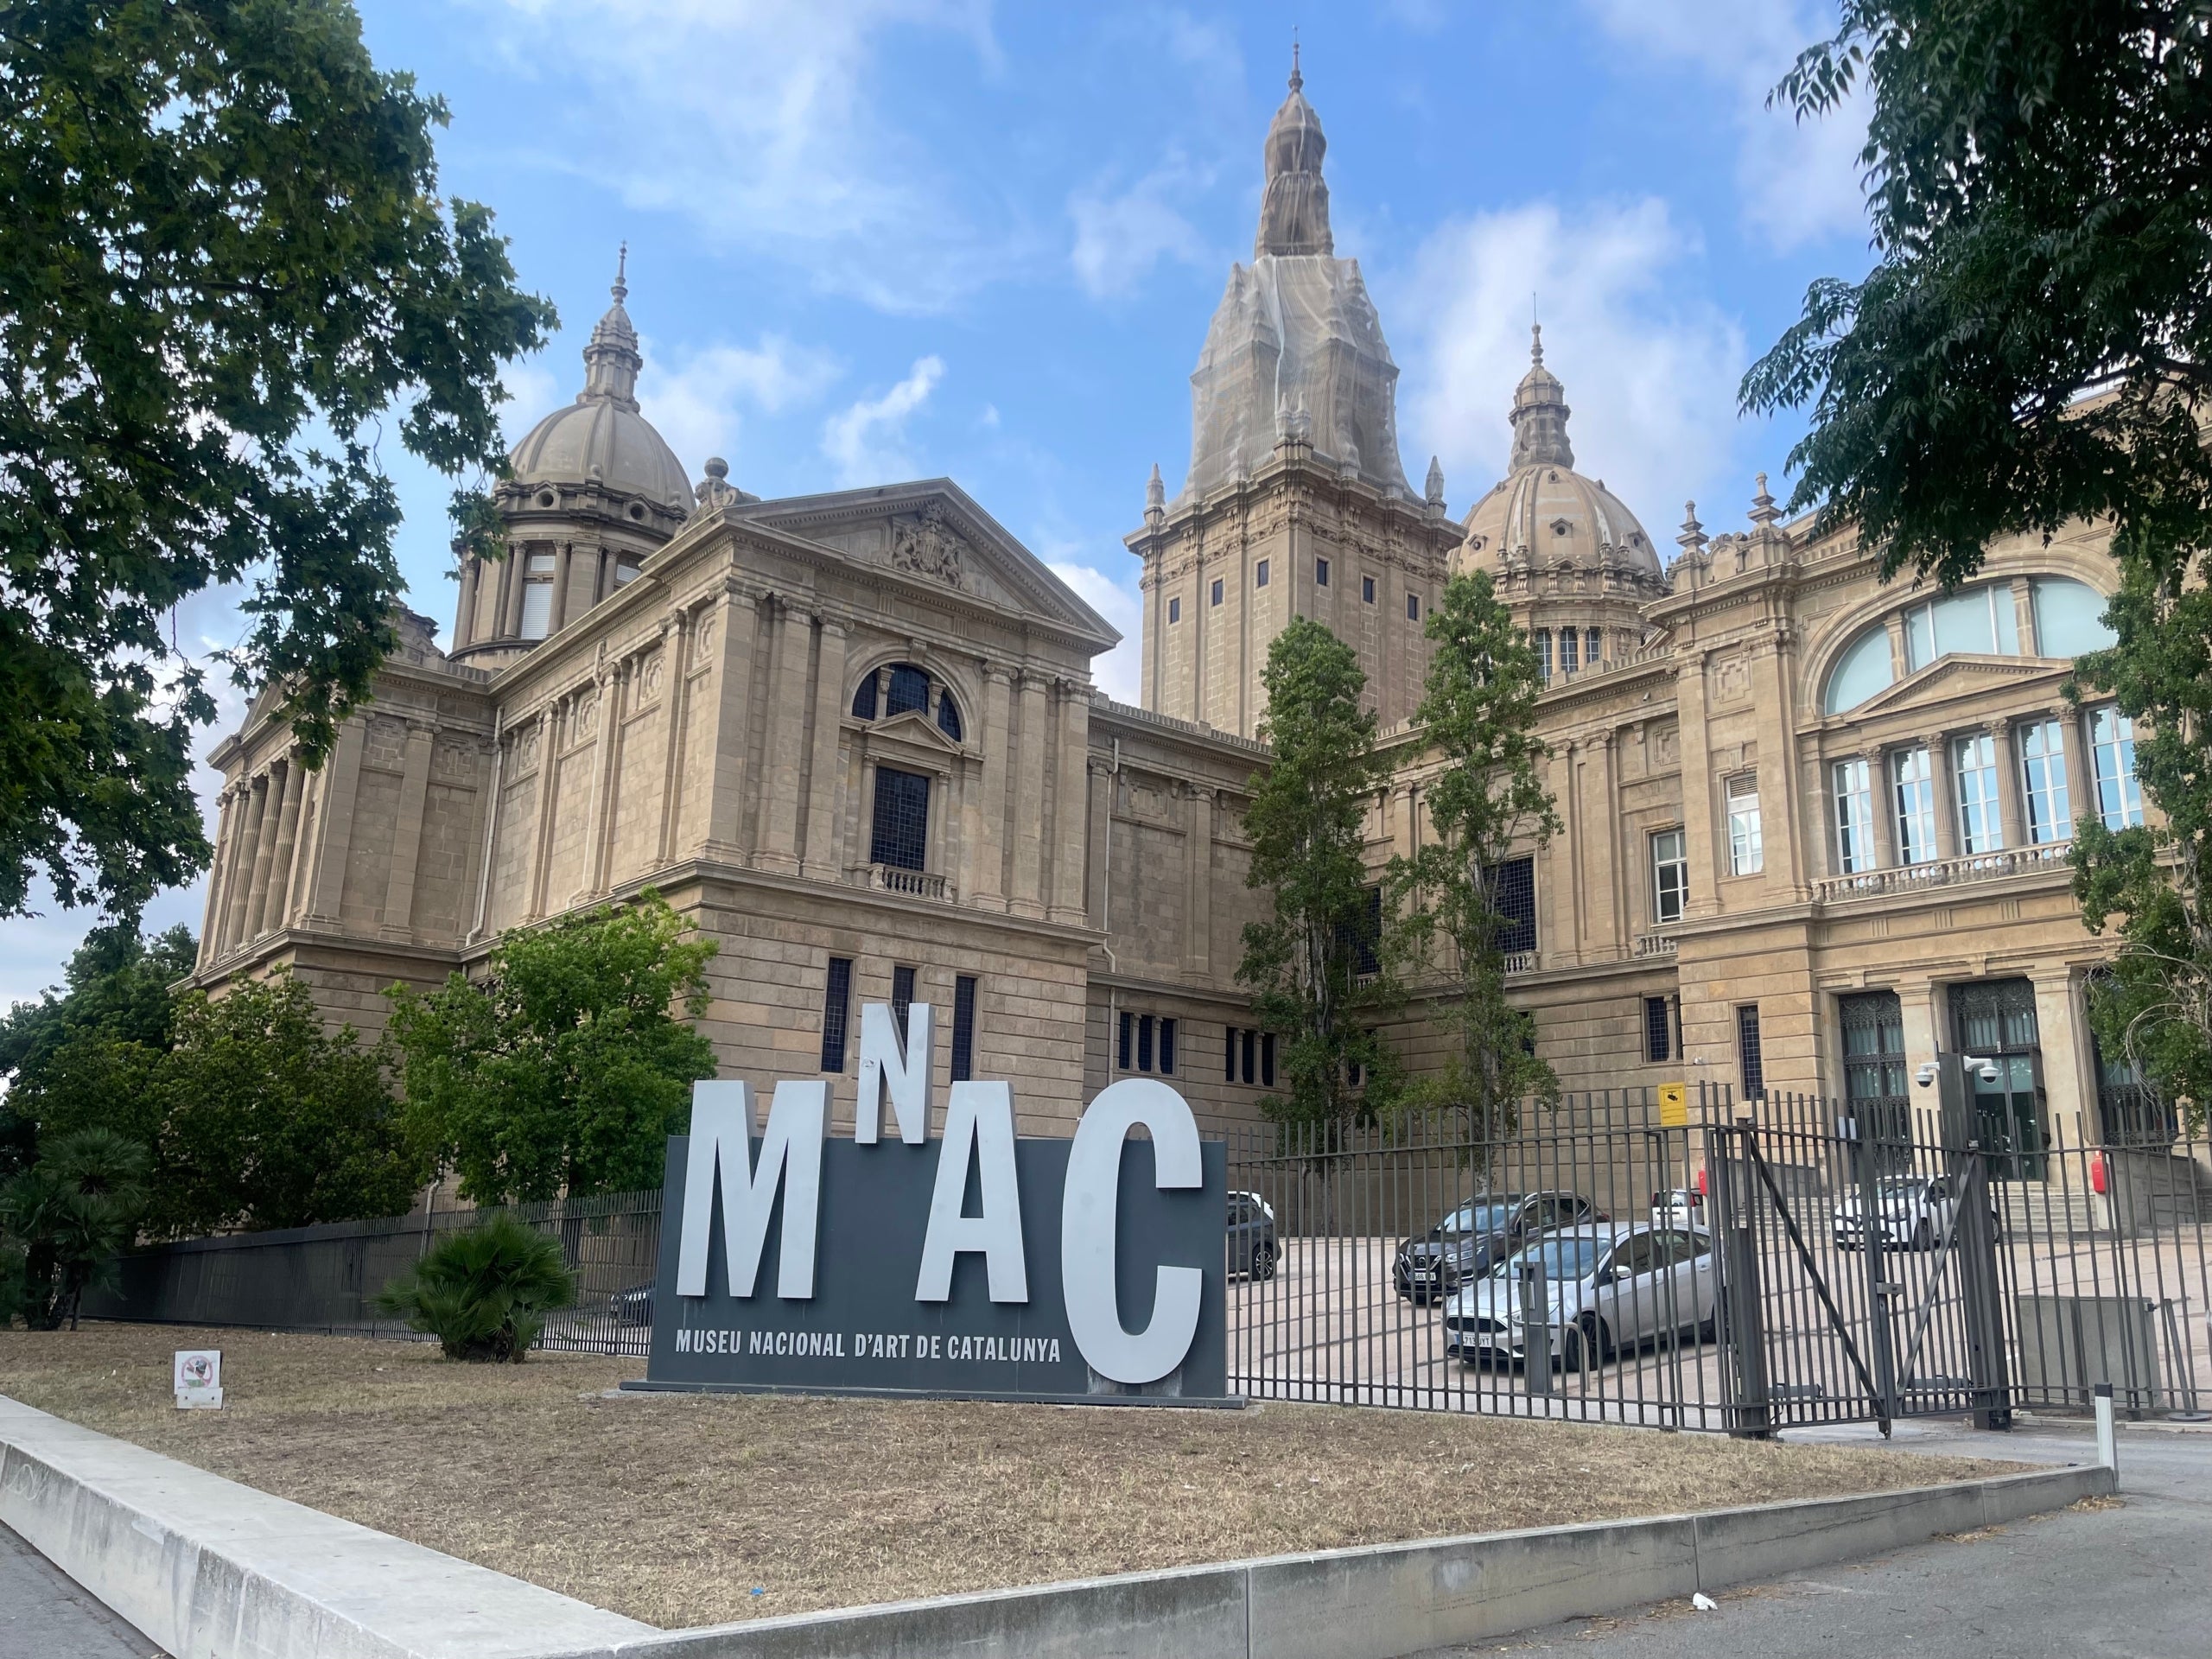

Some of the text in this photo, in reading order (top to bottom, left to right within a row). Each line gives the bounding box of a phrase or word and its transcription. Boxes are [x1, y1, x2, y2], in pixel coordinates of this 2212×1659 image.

[675, 1329, 1061, 1363] MUSEU NACIONAL D'ART DE CATALUNYA
